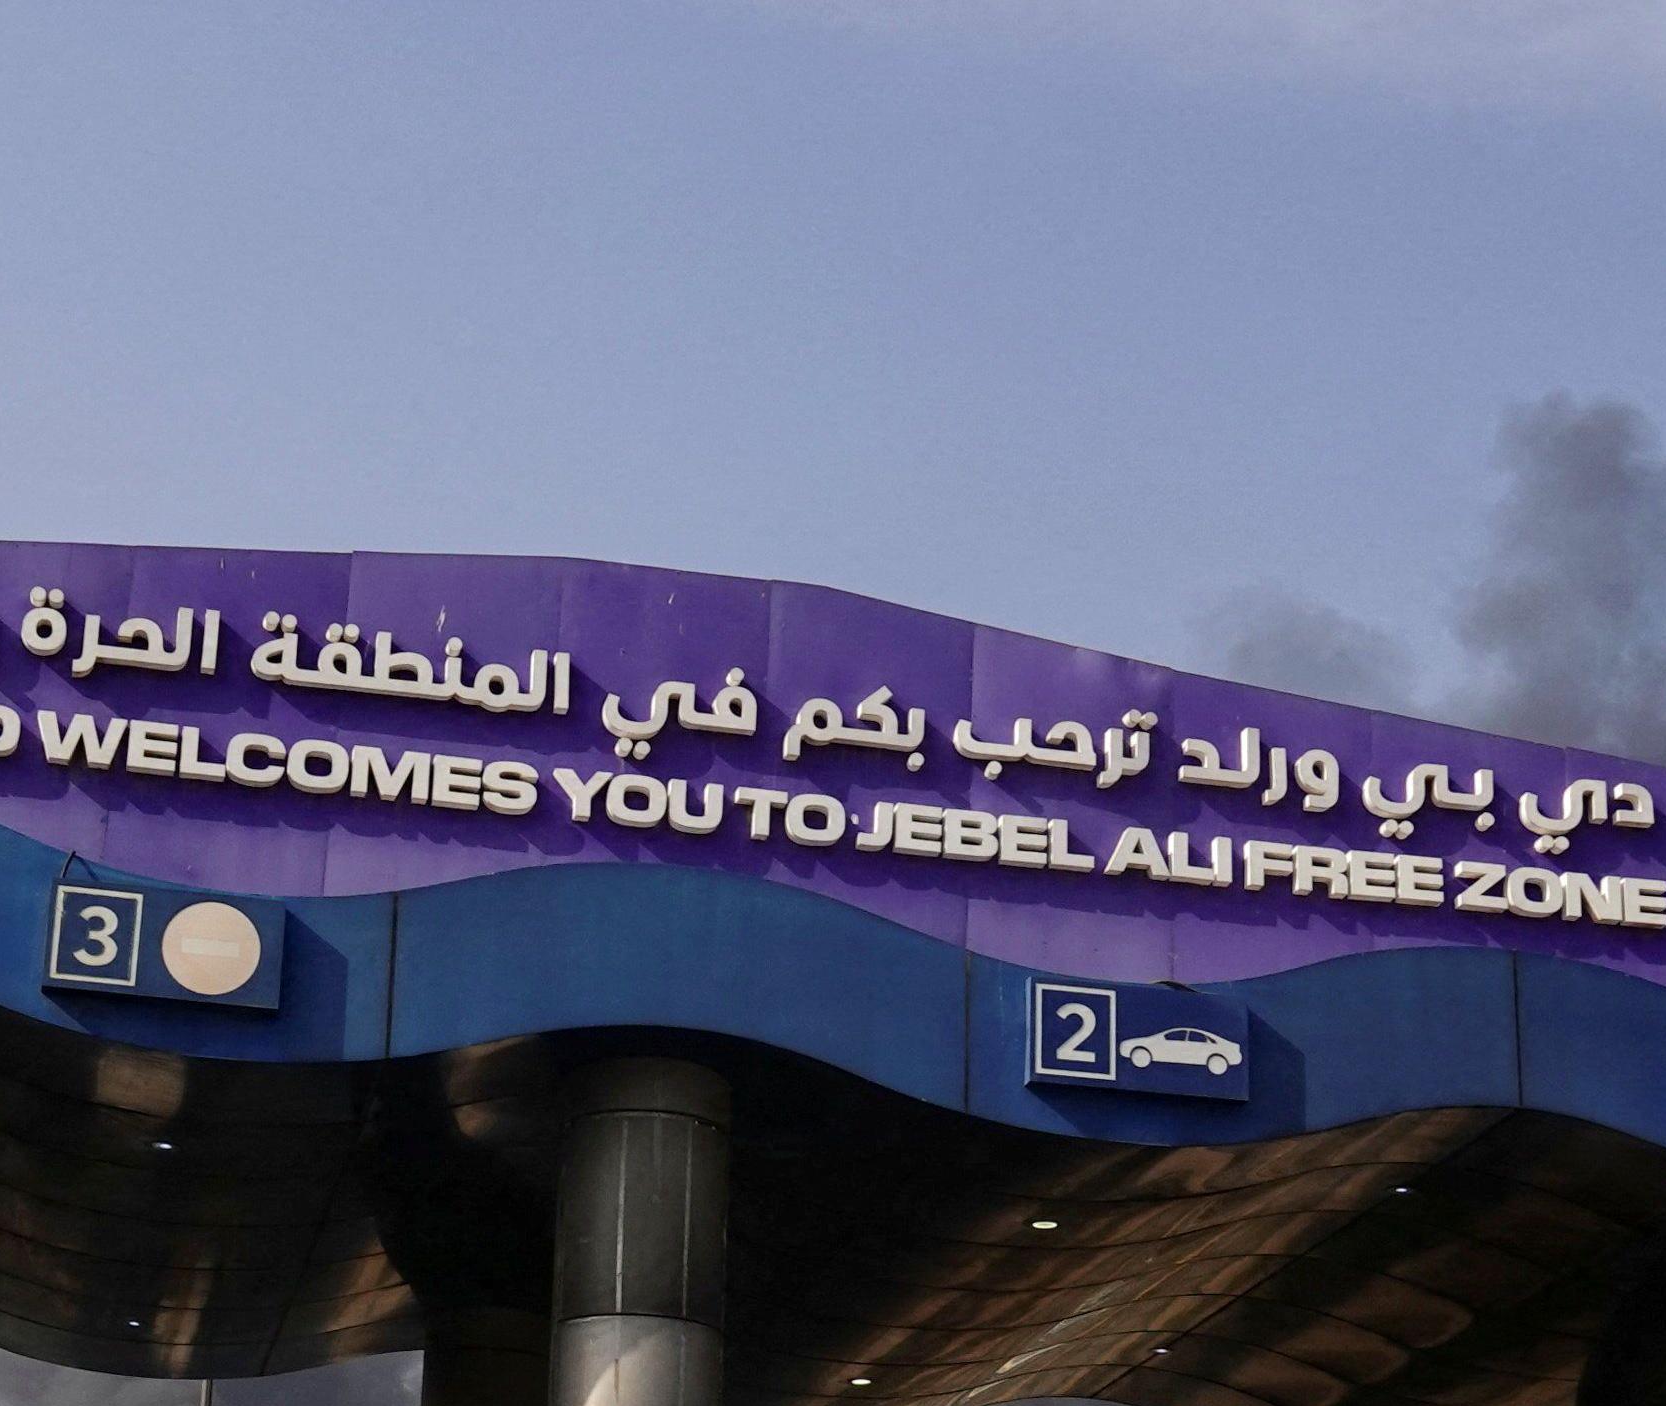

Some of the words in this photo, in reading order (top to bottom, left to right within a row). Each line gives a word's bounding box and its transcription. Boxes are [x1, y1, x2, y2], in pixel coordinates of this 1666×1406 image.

[20, 585, 221, 677] الحرة
[250, 605, 571, 716] المنطقة
[601, 666, 758, 759] في
[782, 684, 926, 772] بكم
[952, 708, 1159, 790] ترحب
[35, 709, 540, 817] WELCOMES
[552, 767, 724, 835] YOU
[733, 786, 846, 847] TO
[854, 800, 1097, 873] JEBEL
[1103, 827, 1233, 888] ALI
[1242, 839, 1445, 907] FREE
[1178, 726, 1340, 812] ورلد
[1362, 763, 1496, 840] بي
[1519, 778, 1655, 855] دي
[71, 904, 118, 966] 3
[1055, 1003, 1096, 1063] 2
